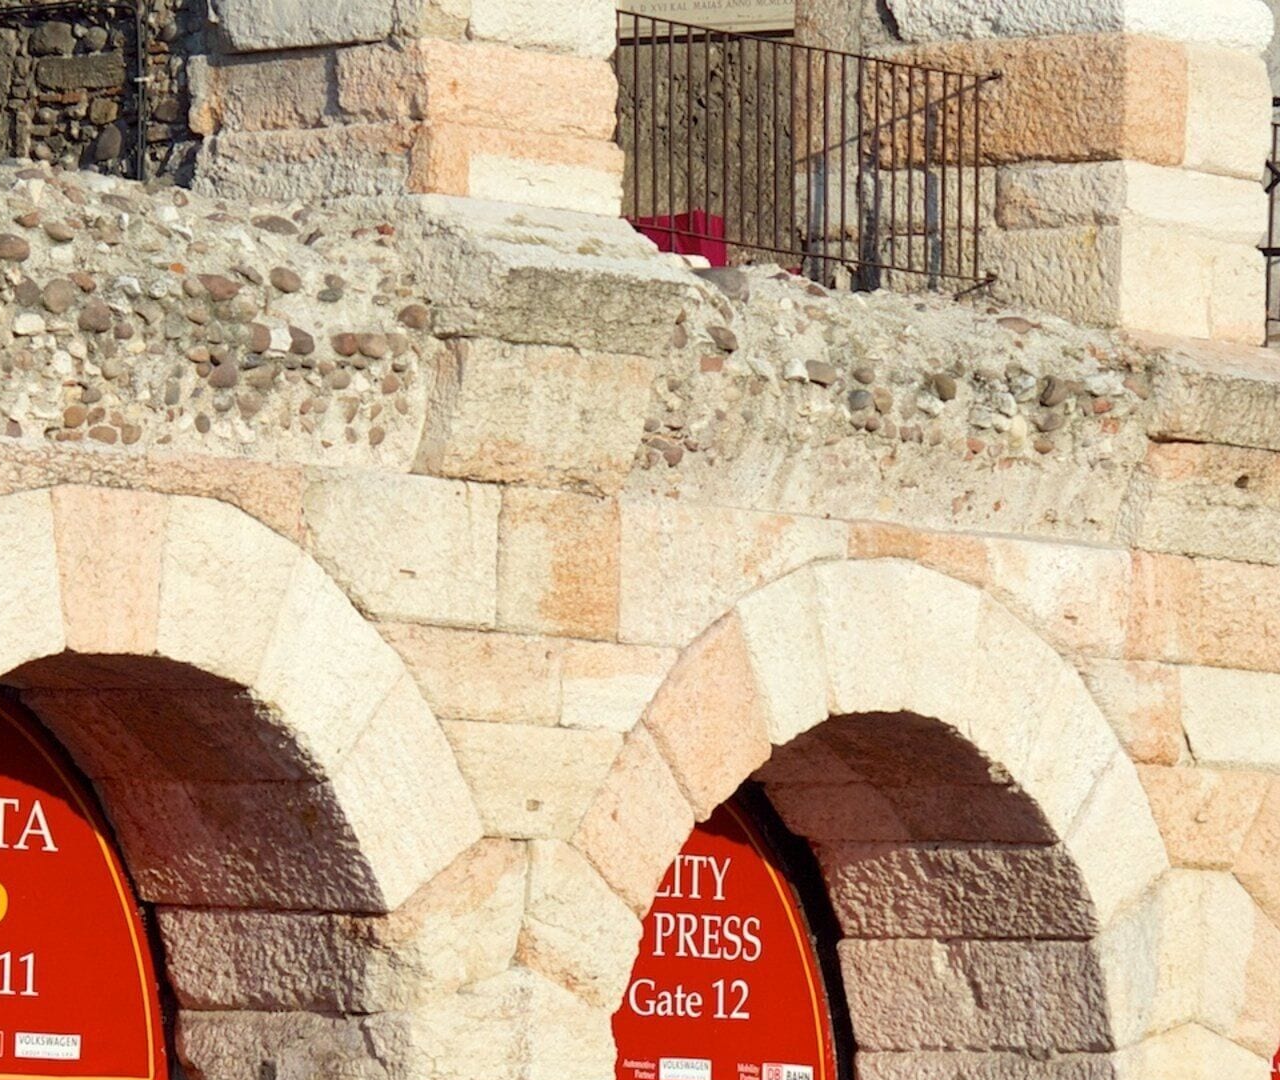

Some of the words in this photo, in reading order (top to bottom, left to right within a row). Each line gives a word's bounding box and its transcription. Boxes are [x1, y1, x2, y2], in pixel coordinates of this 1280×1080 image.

[652, 911, 762, 962] PRESS
[628, 978, 704, 1018] Gate
[711, 979, 751, 1020] 12
[19, 1035, 78, 1047] VOLKSWAGEN
